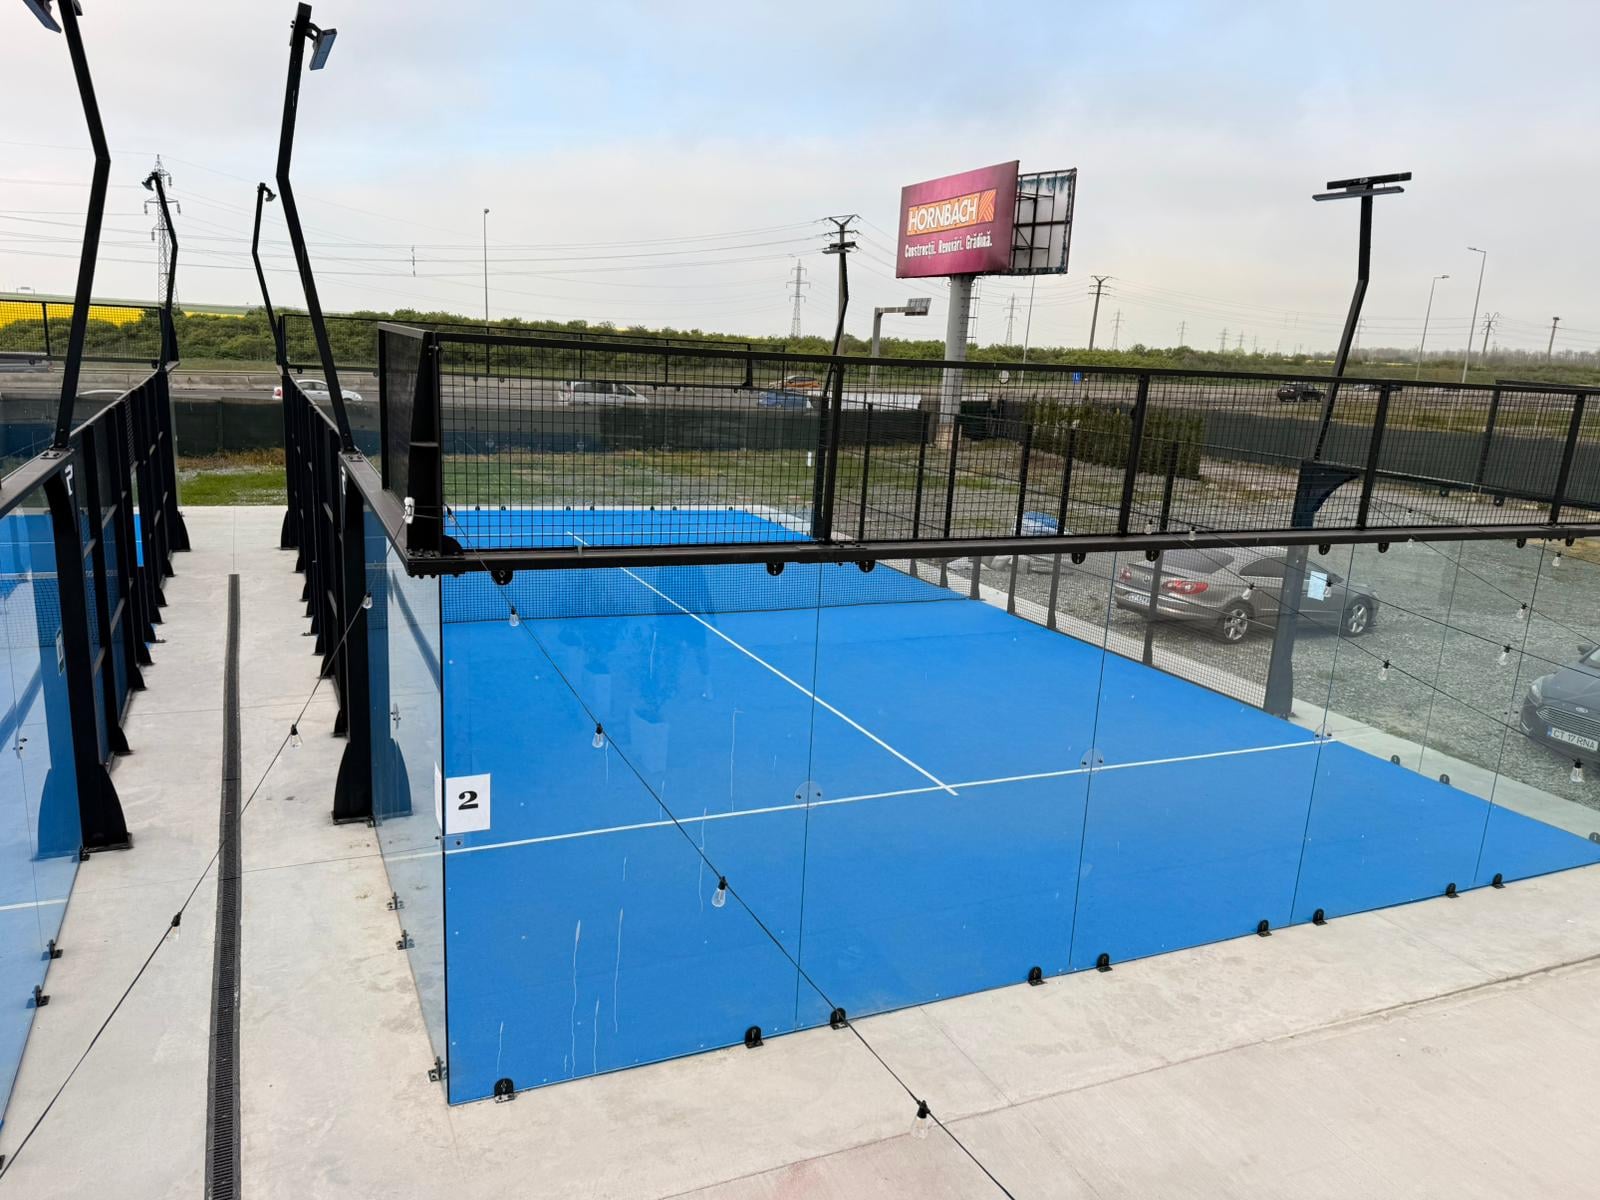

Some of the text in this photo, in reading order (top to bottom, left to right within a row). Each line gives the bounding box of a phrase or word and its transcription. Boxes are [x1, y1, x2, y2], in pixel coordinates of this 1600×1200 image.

[908, 197, 978, 231] HORNBACH
[965, 231, 993, 250] Grădină.
[1553, 729, 1565, 740] CT
[458, 790, 479, 811] 2
